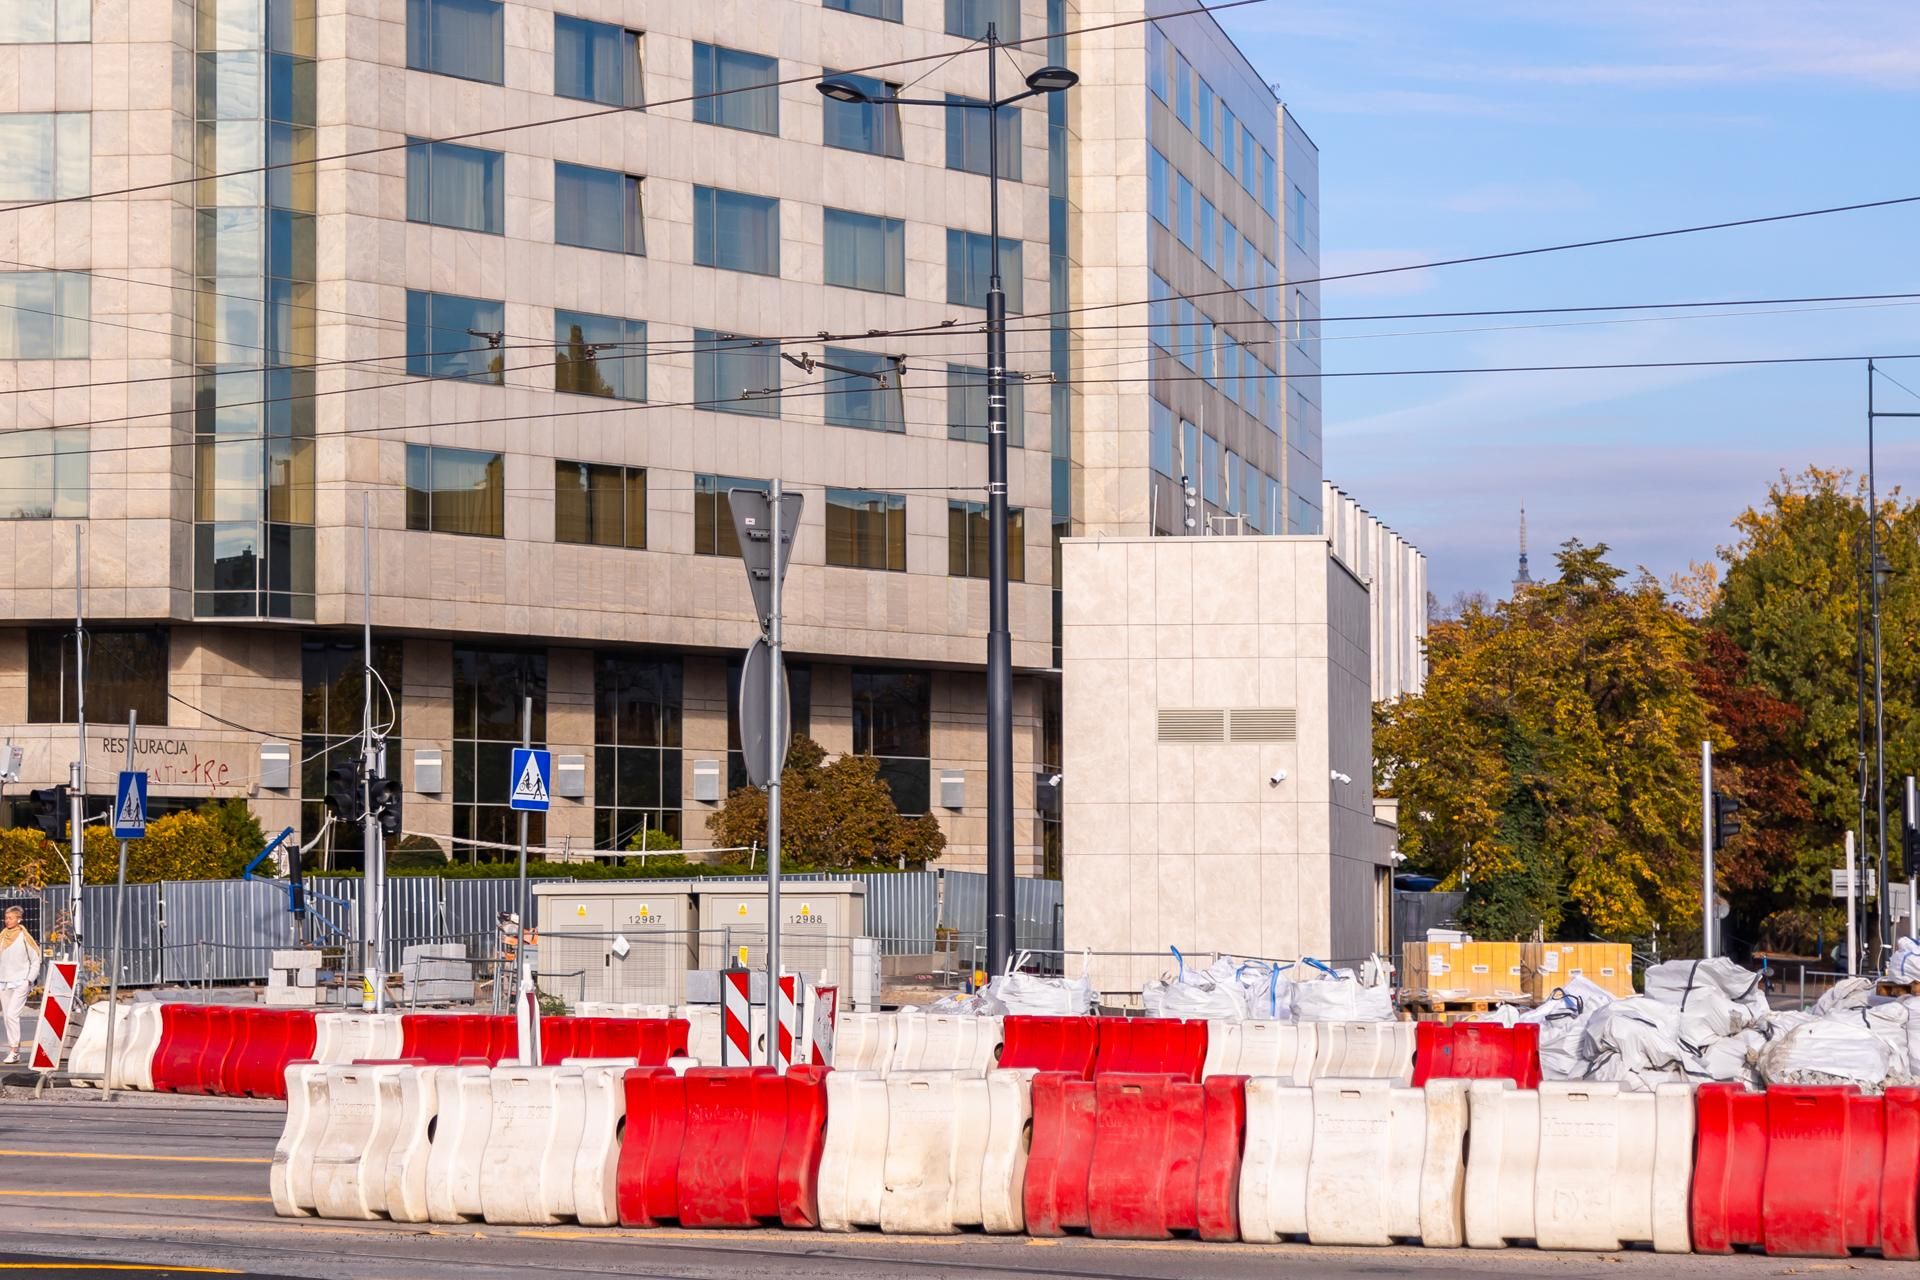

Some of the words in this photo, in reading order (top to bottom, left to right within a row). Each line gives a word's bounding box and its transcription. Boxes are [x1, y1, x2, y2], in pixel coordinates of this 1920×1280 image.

[103, 738, 188, 755] RESAURACJA
[629, 915, 662, 924] 12987
[790, 915, 822, 924] 12988
